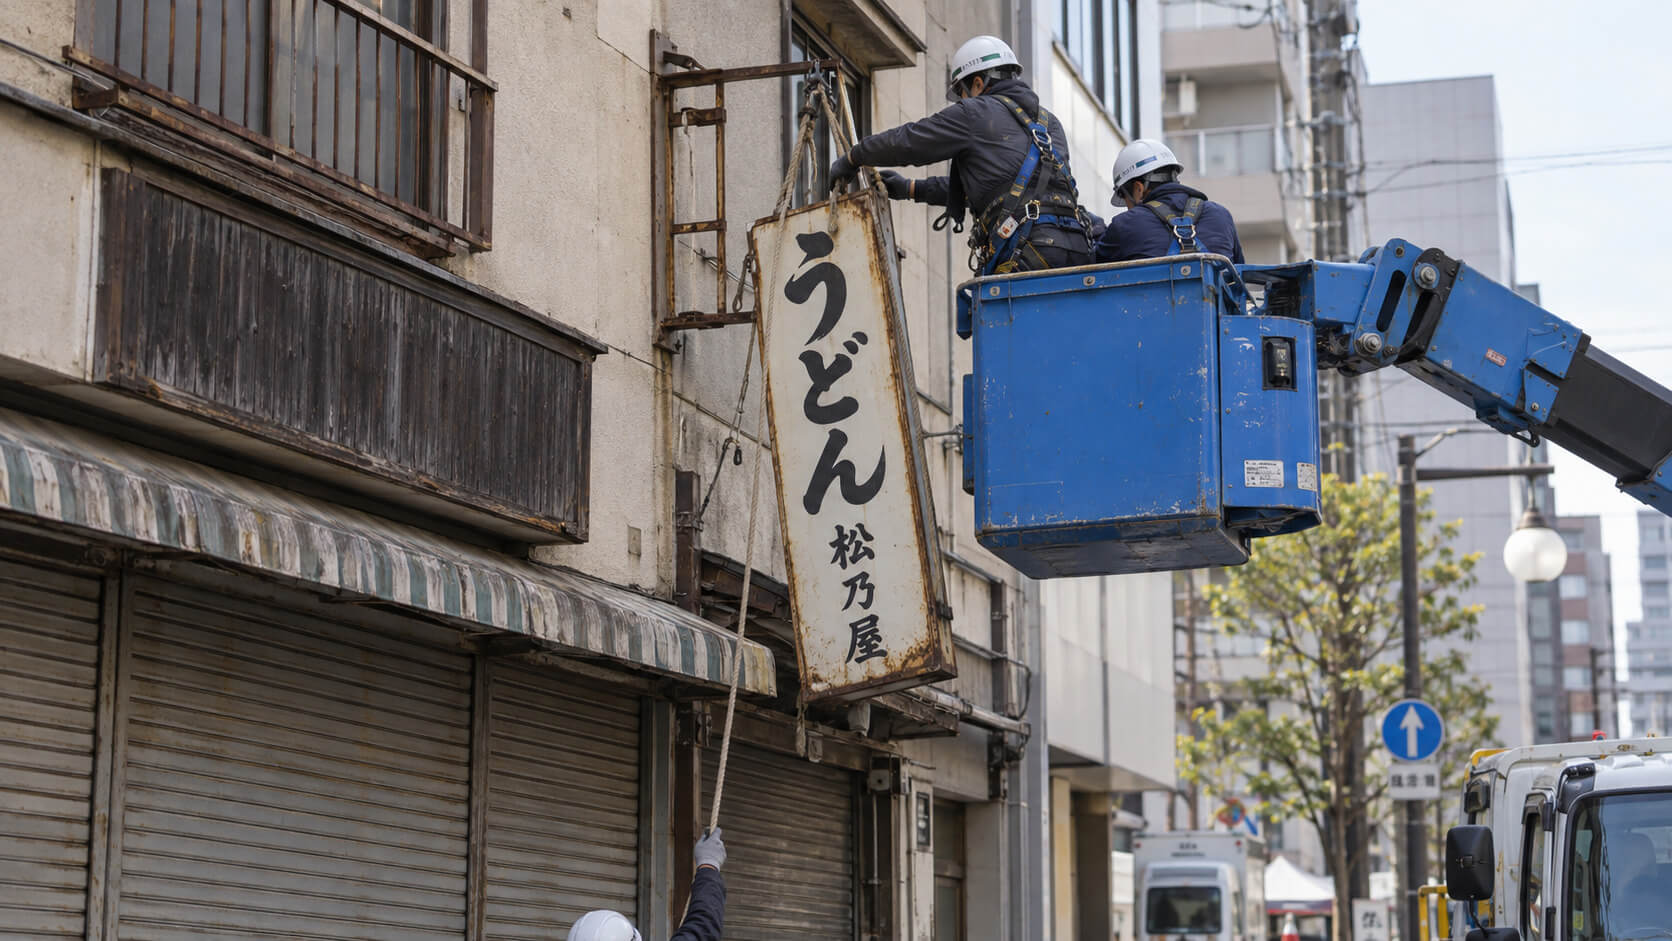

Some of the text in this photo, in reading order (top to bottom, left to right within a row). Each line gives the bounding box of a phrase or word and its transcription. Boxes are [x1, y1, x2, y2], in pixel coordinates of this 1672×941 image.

[784, 231, 886, 516] うどん
[828, 523, 888, 665] 松乃屋
